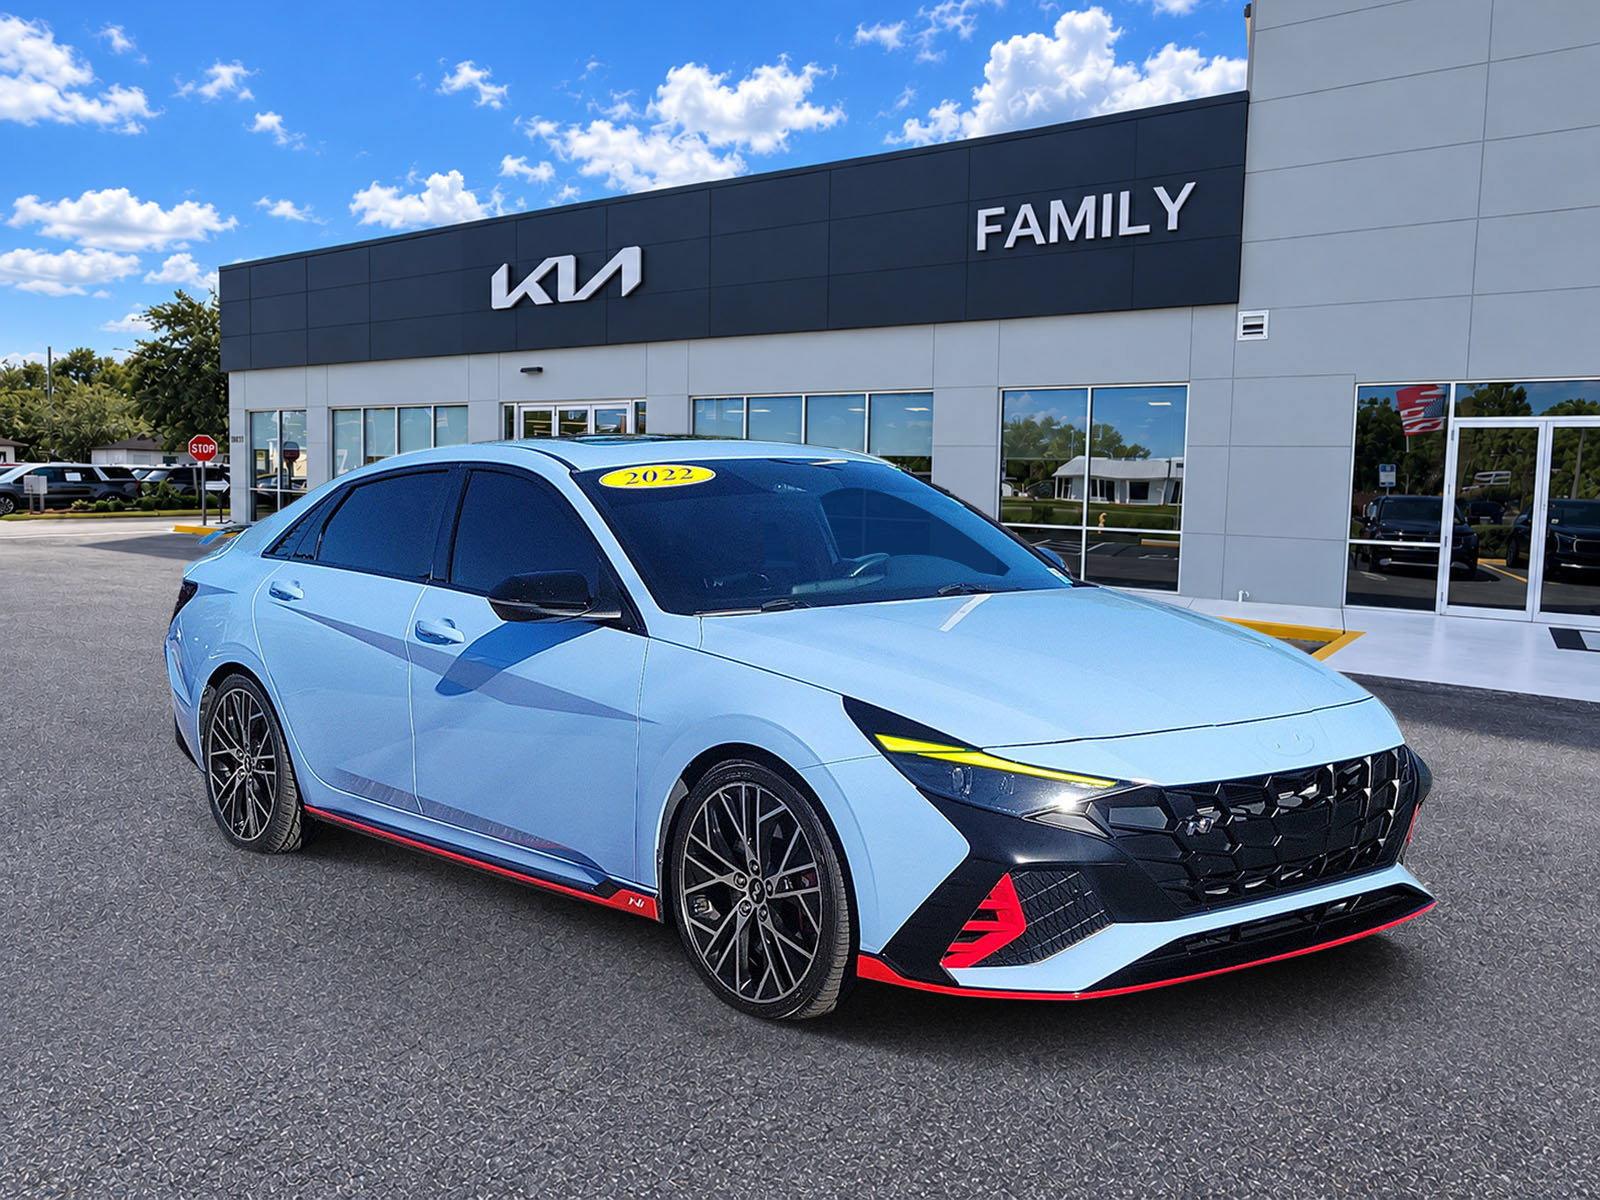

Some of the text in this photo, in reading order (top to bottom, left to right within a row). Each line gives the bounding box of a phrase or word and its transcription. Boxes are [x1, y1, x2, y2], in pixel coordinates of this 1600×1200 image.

[976, 181, 1197, 251] FAMILY
[491, 245, 642, 310] KIA
[191, 443, 215, 454] STOP
[624, 467, 695, 485] 2022
